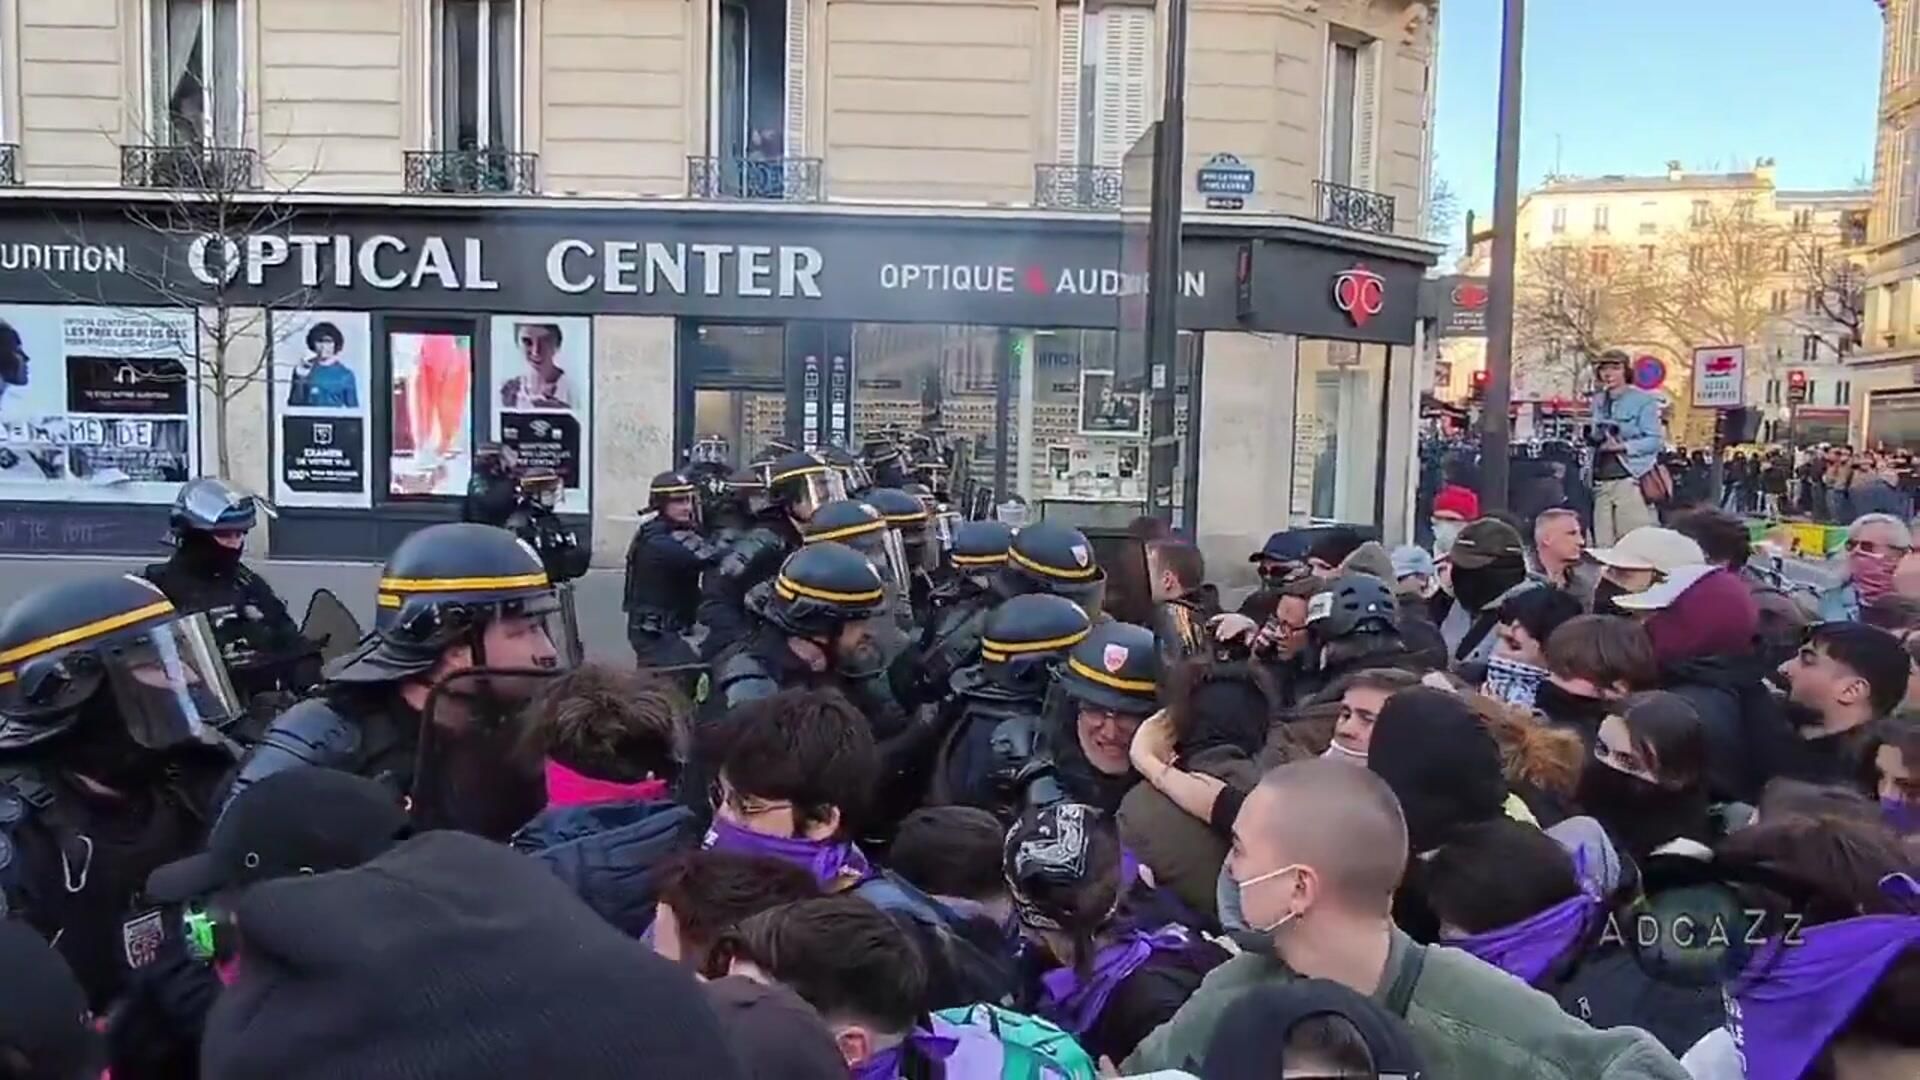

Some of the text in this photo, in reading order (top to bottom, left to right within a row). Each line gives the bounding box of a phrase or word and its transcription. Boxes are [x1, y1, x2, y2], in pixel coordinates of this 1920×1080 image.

[188, 231, 824, 298] OPTICAL CENTER
[880, 264, 1015, 292] OPTIQUE
[1055, 268, 1206, 297] AUDN
